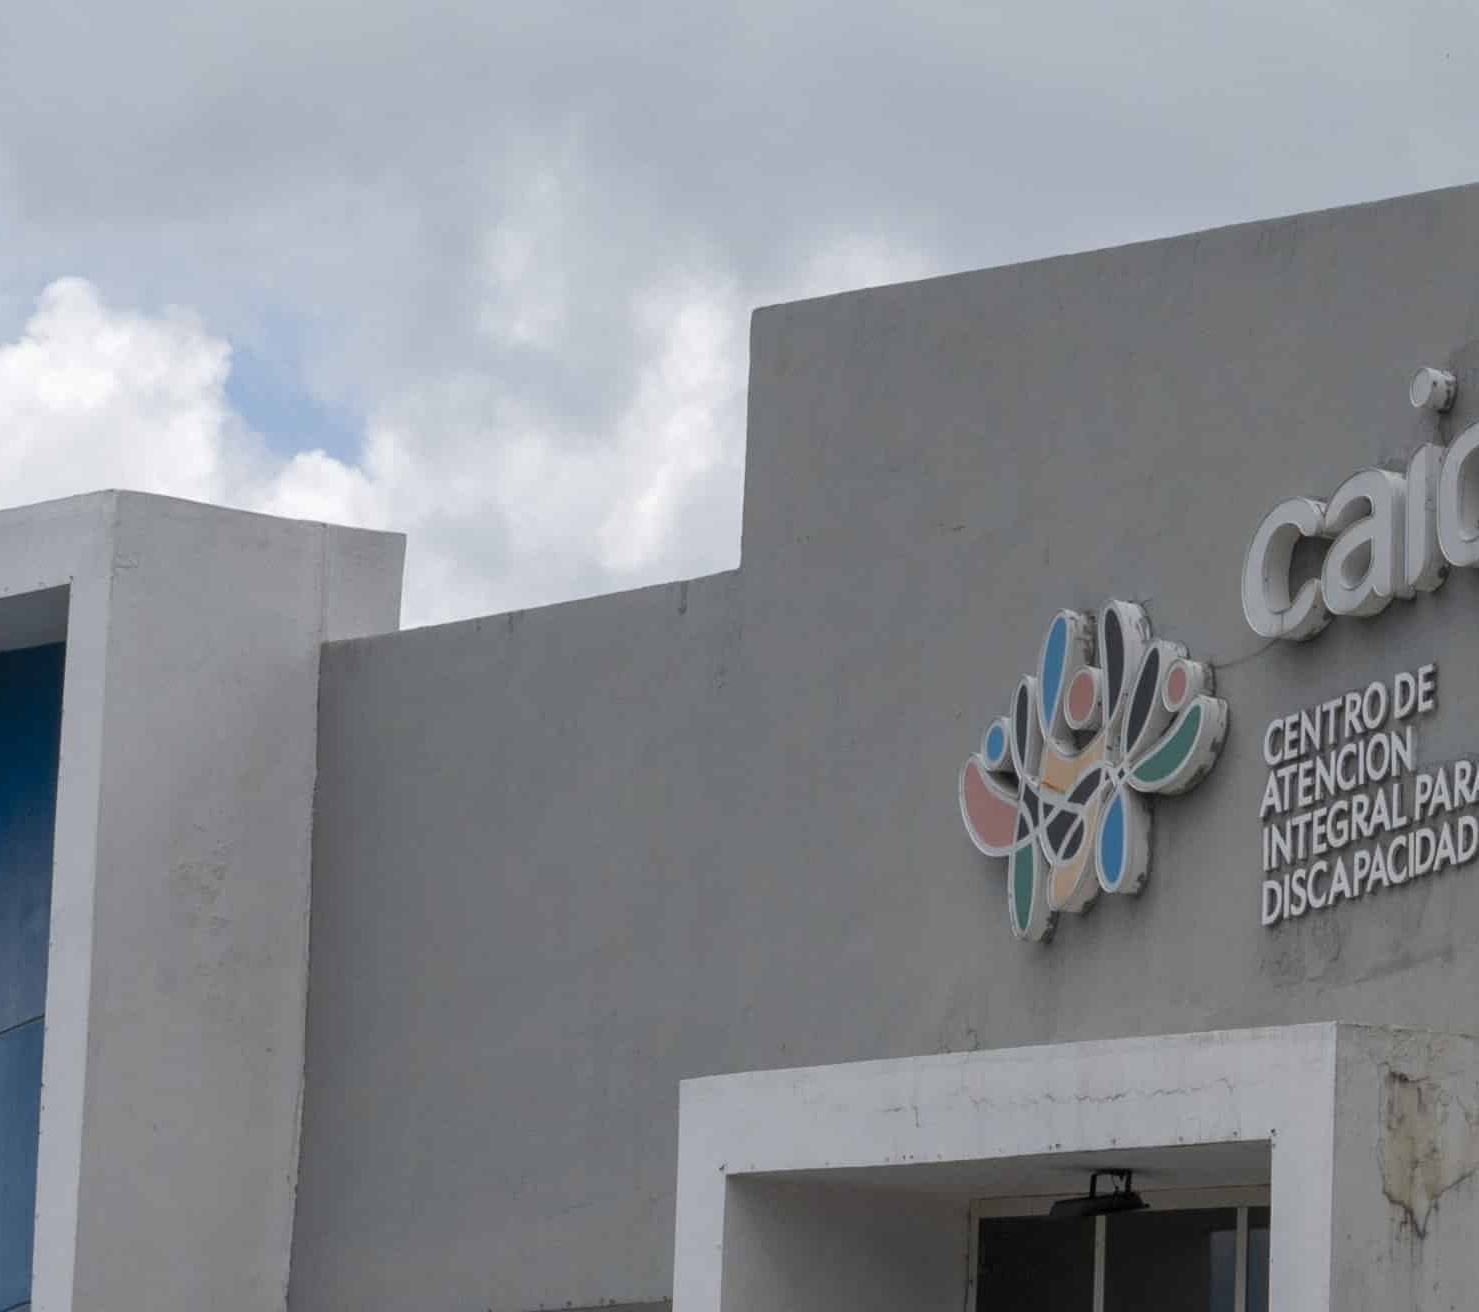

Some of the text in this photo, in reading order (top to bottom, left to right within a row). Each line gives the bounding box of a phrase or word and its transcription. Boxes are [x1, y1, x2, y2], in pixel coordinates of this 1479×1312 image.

[1264, 663, 1435, 766] CENTRO DE
[1259, 726, 1416, 818] ATENCION
[1262, 783, 1408, 871] INTEGRAL
[1262, 816, 1479, 926] DISCAPACIDAD
